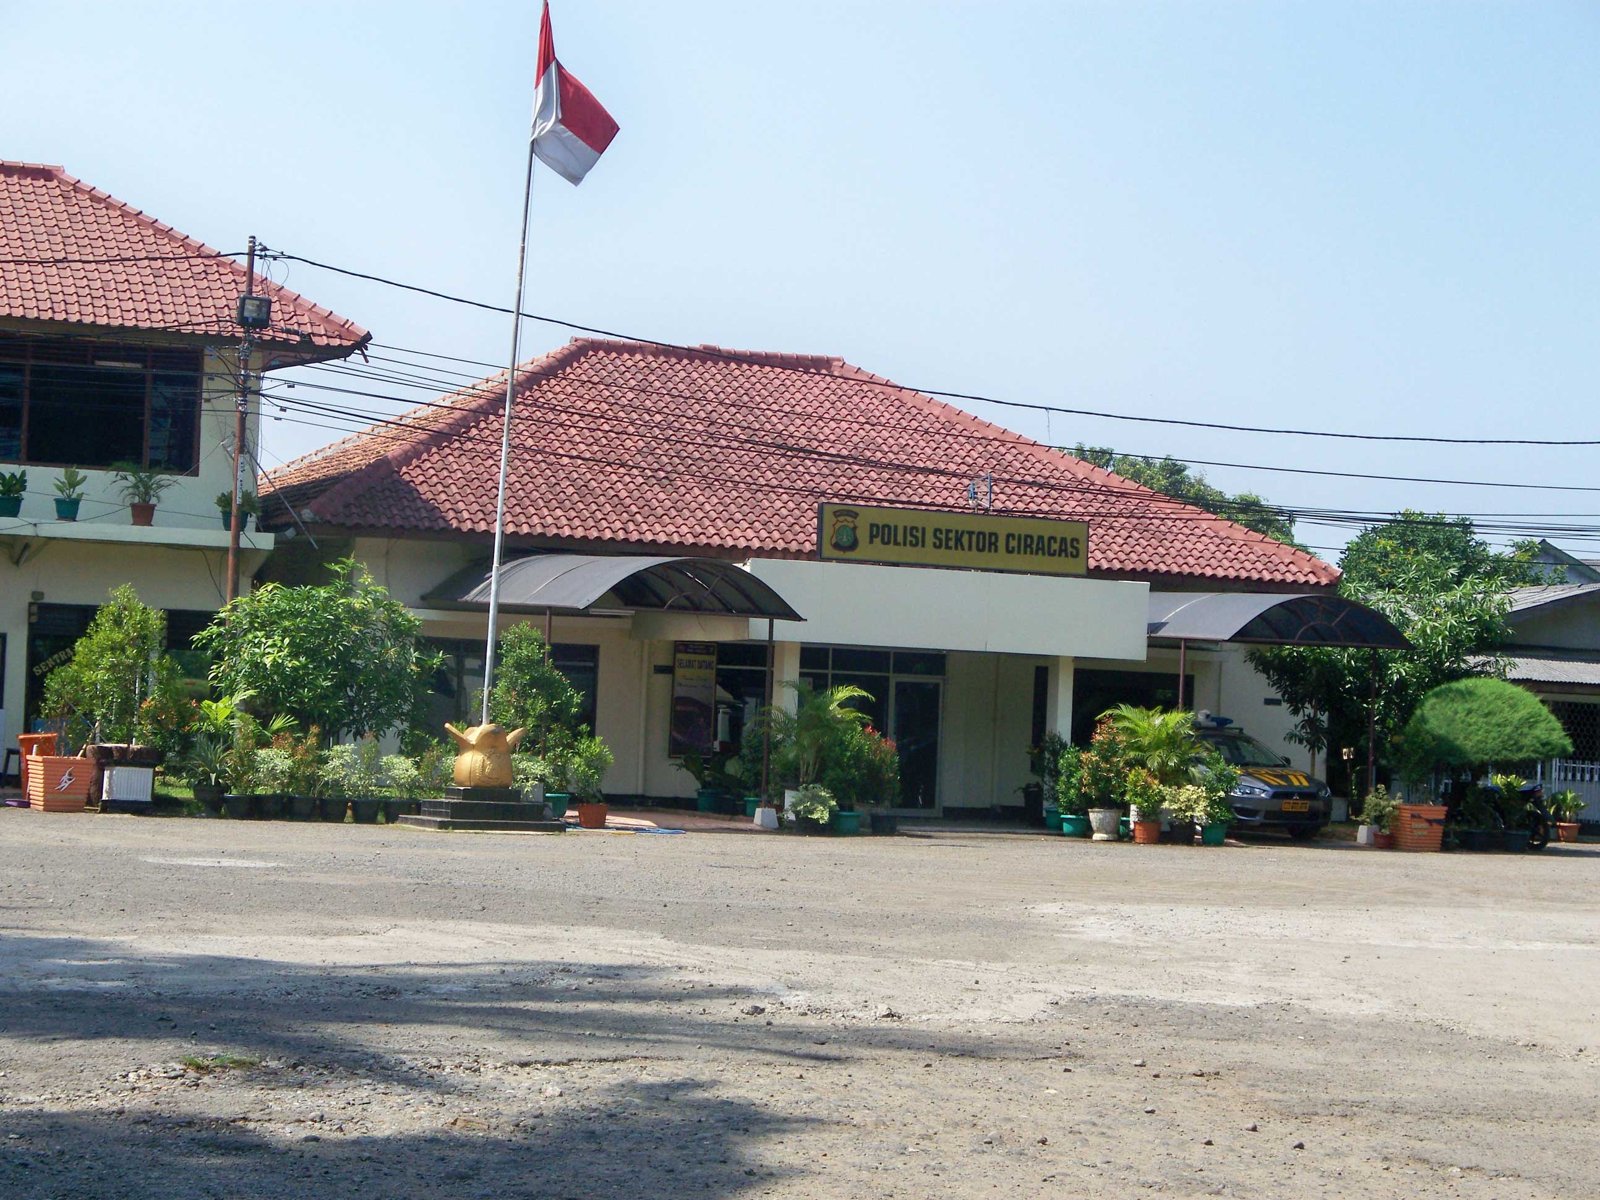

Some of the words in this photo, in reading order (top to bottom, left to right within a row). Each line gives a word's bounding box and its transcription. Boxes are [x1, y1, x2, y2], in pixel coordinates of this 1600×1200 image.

[868, 522, 926, 548] POLISI
[932, 527, 999, 554] SEKTOR
[1005, 533, 1080, 559] CIRACAS
[32, 647, 73, 676] SENTRA
